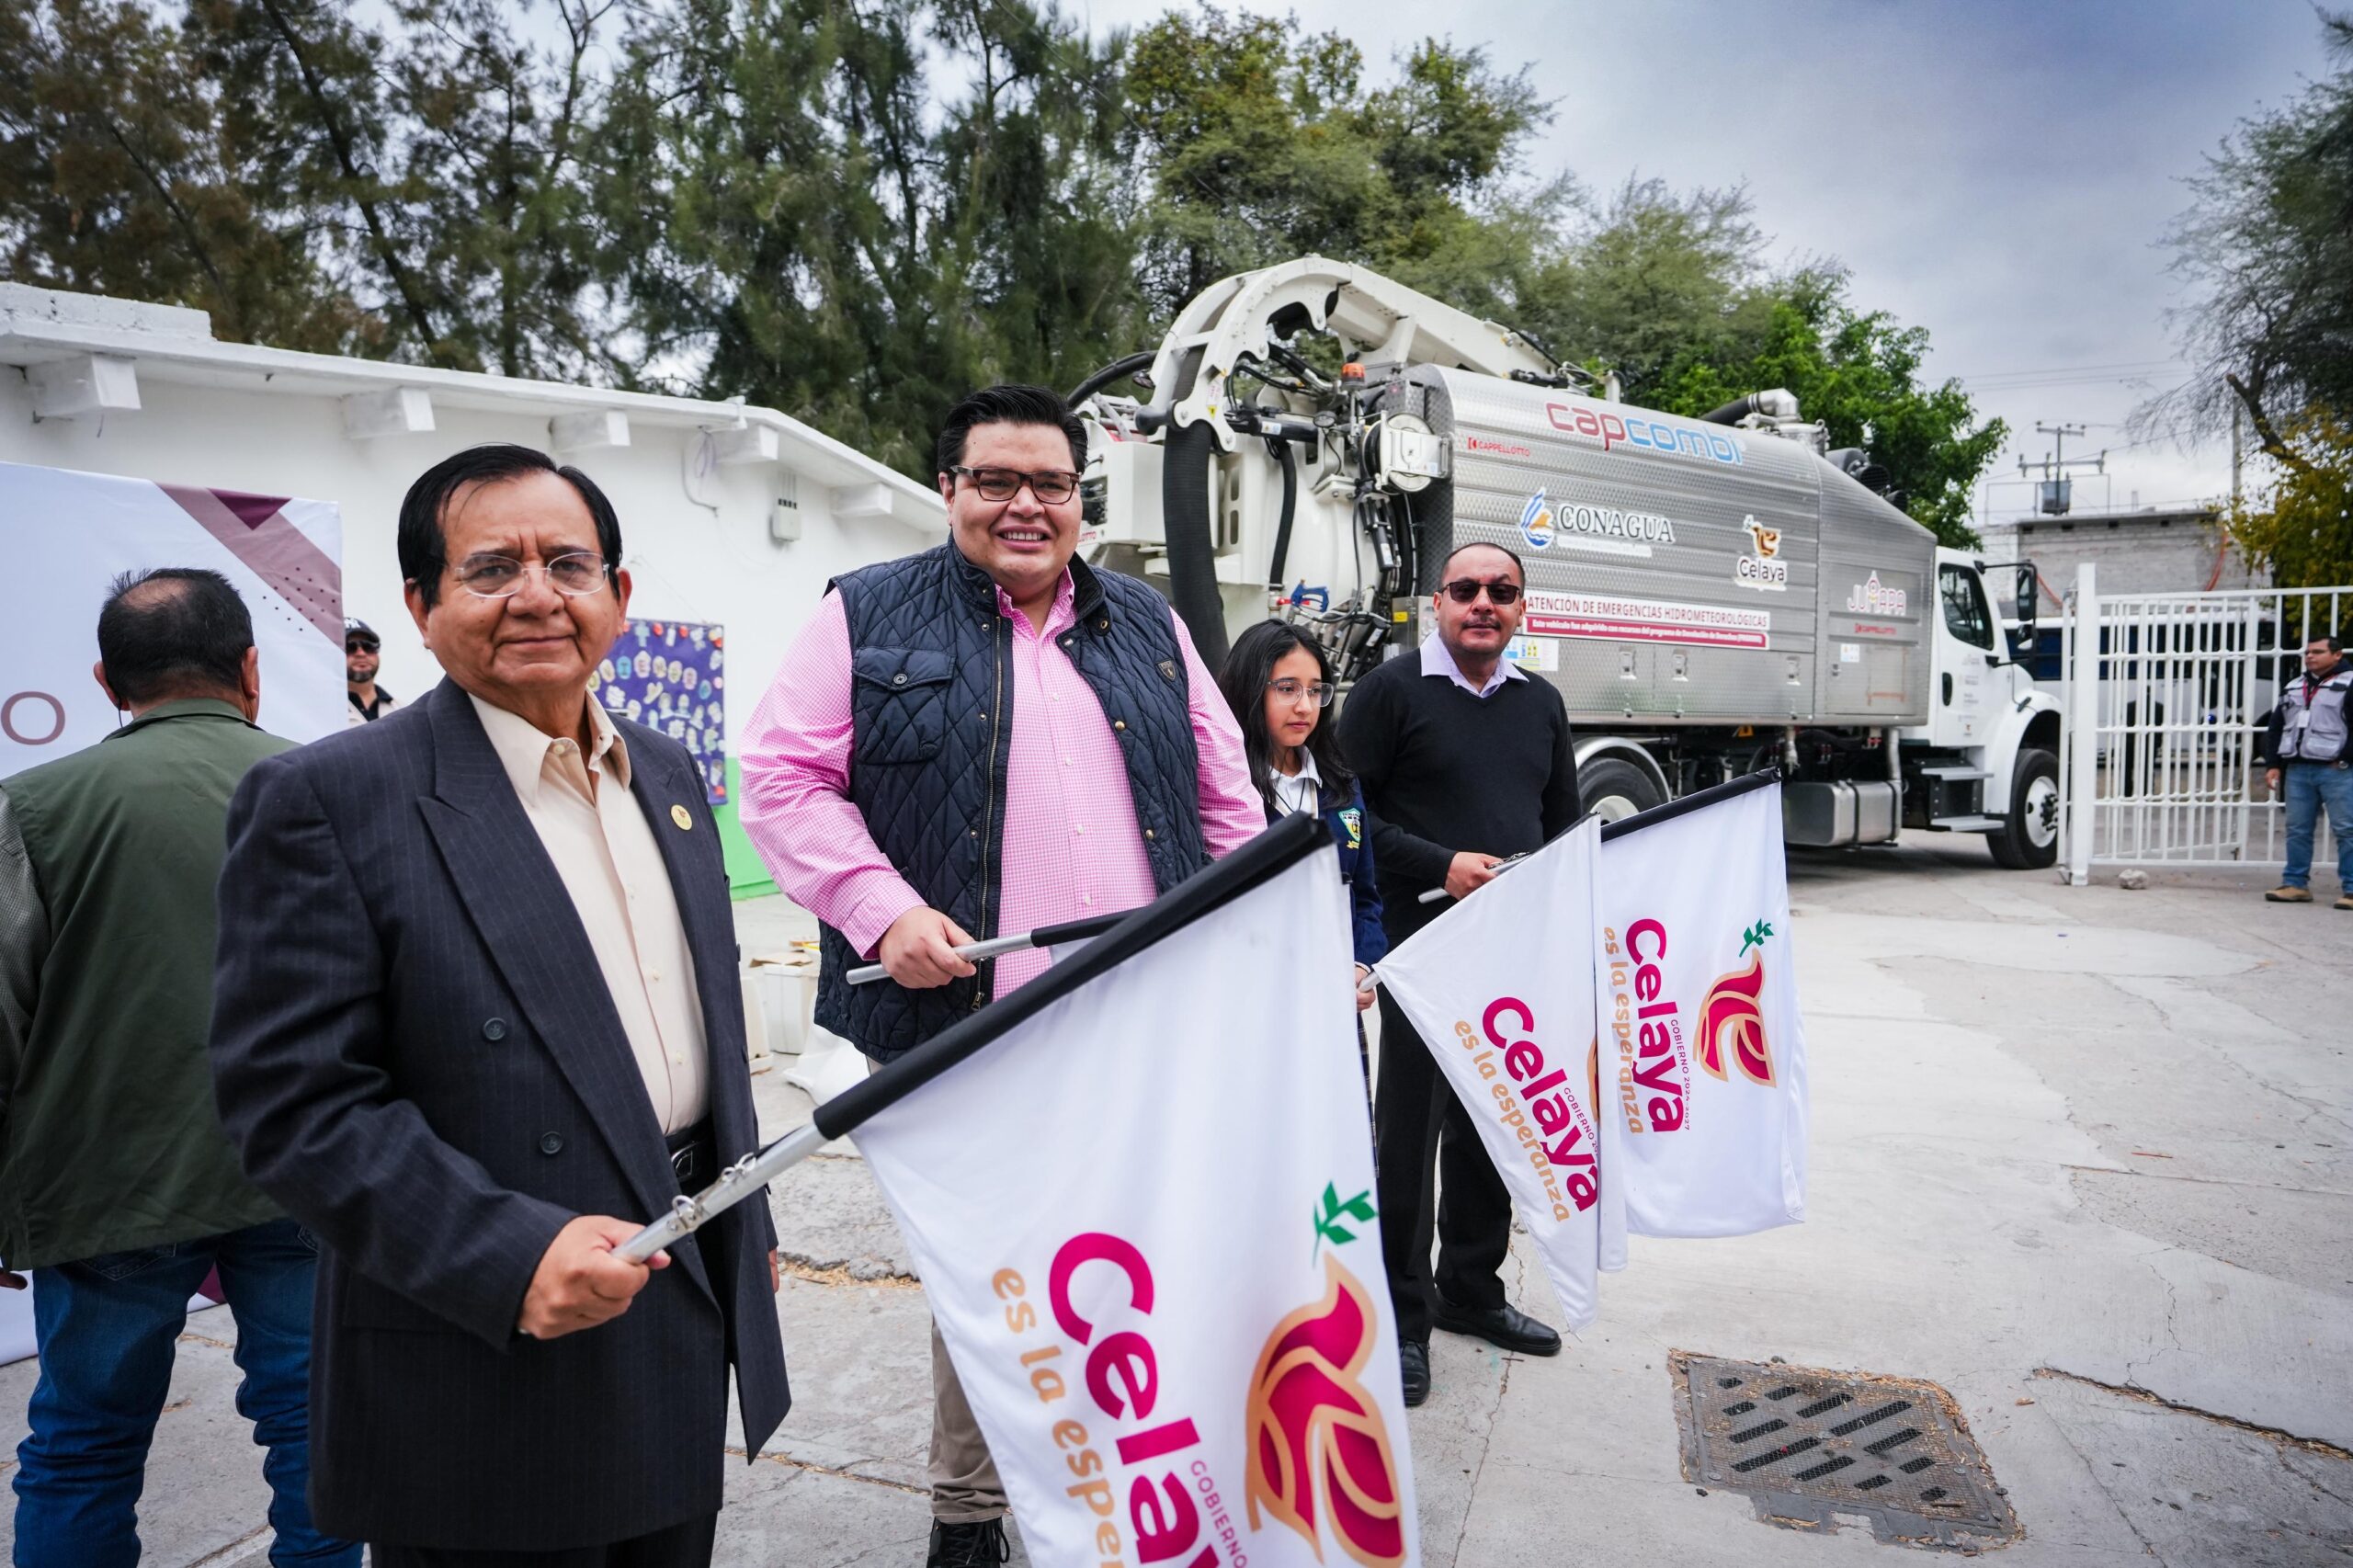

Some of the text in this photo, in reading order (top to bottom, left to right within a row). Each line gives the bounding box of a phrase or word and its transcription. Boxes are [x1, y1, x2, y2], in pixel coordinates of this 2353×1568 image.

[1546, 403, 1742, 463] capcombi
[1560, 506, 1674, 542] CONAGUA
[1739, 559, 1784, 582] Celaya
[1528, 596, 1767, 627] ATENCIÓN DE EMERGENCIAS HIDROMETEOROLÓGICAS
[1603, 926, 1644, 1134] es la esperanza
[1625, 918, 1684, 1132] Celaya
[1671, 1019, 1689, 1074] GOBIERNO
[1454, 1020, 1570, 1222] es la esperanza
[1482, 996, 1598, 1212] Celaya
[1563, 1087, 1595, 1140] GOBIERNO
[992, 1267, 1125, 1568] es la espe
[1048, 1232, 1220, 1568] Cela
[1191, 1460, 1247, 1568] GOBIERNO
